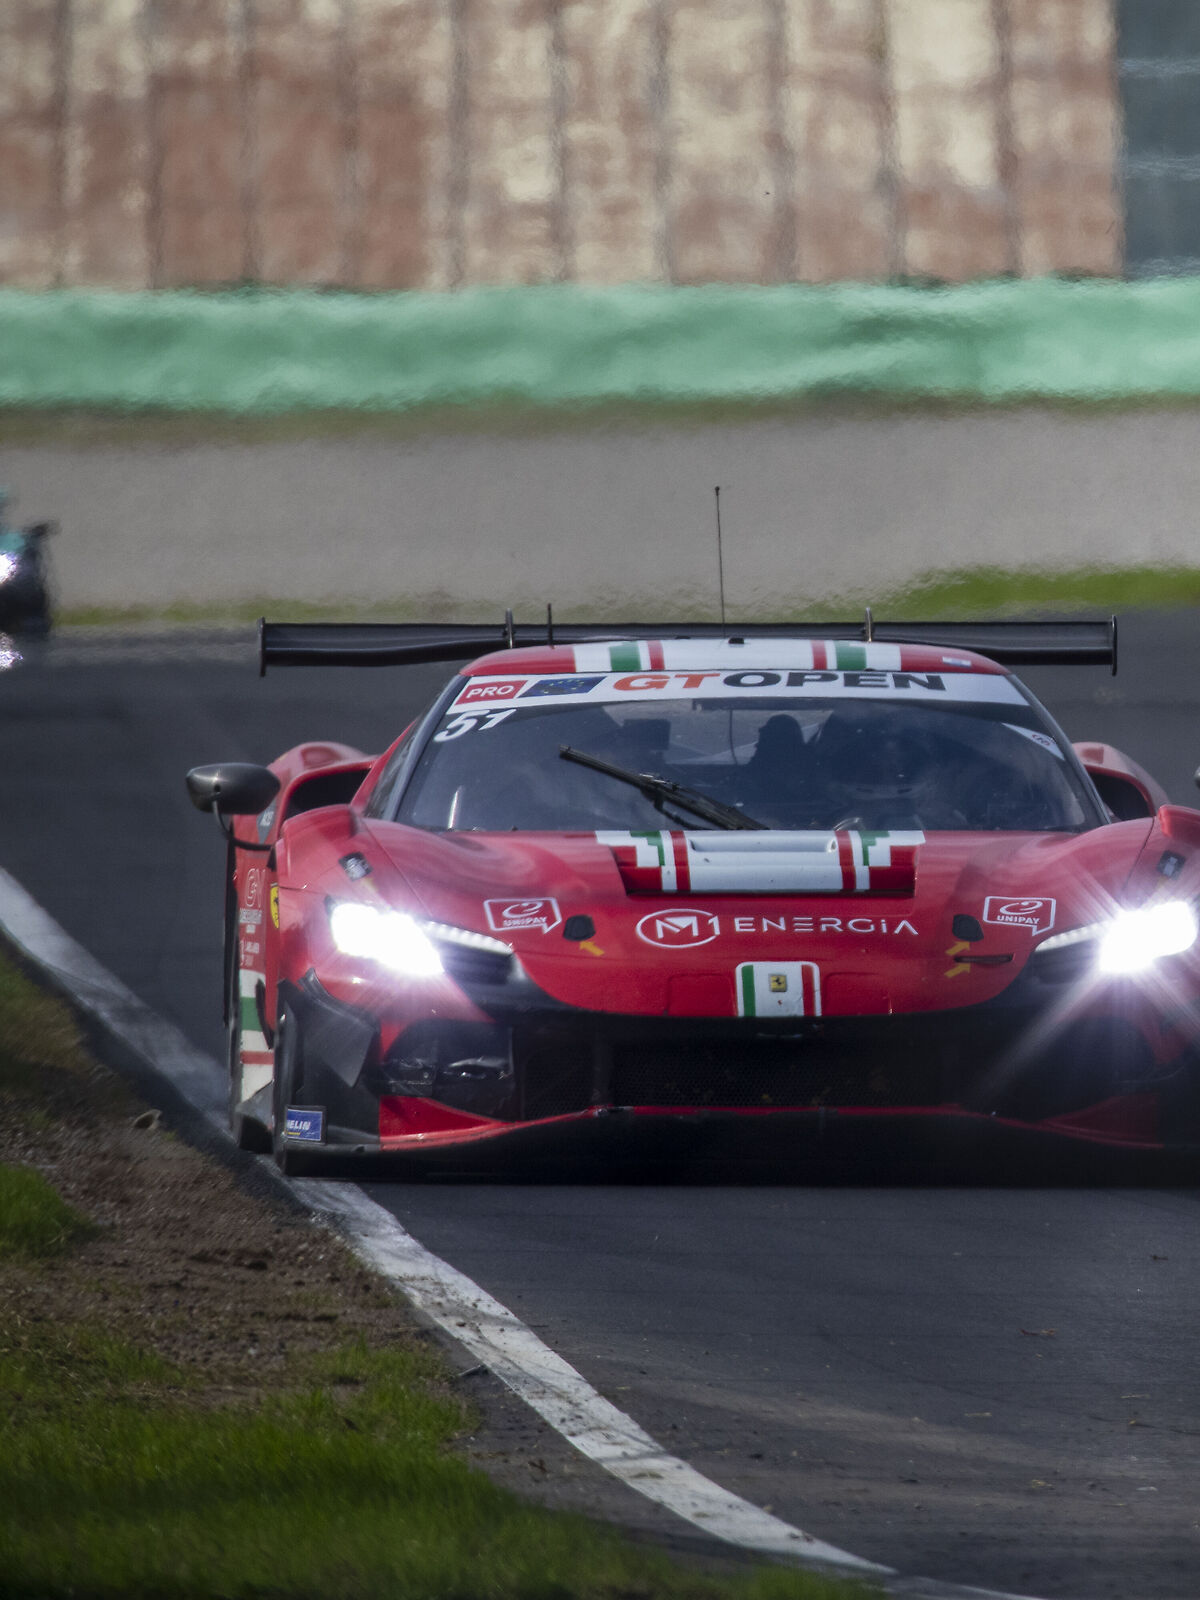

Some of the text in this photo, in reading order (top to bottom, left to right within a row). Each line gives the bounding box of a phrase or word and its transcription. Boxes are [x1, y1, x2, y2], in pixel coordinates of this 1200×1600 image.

[466, 685, 514, 698] PRO
[433, 709, 517, 742] 51
[996, 915, 1040, 925] UNIPAY
